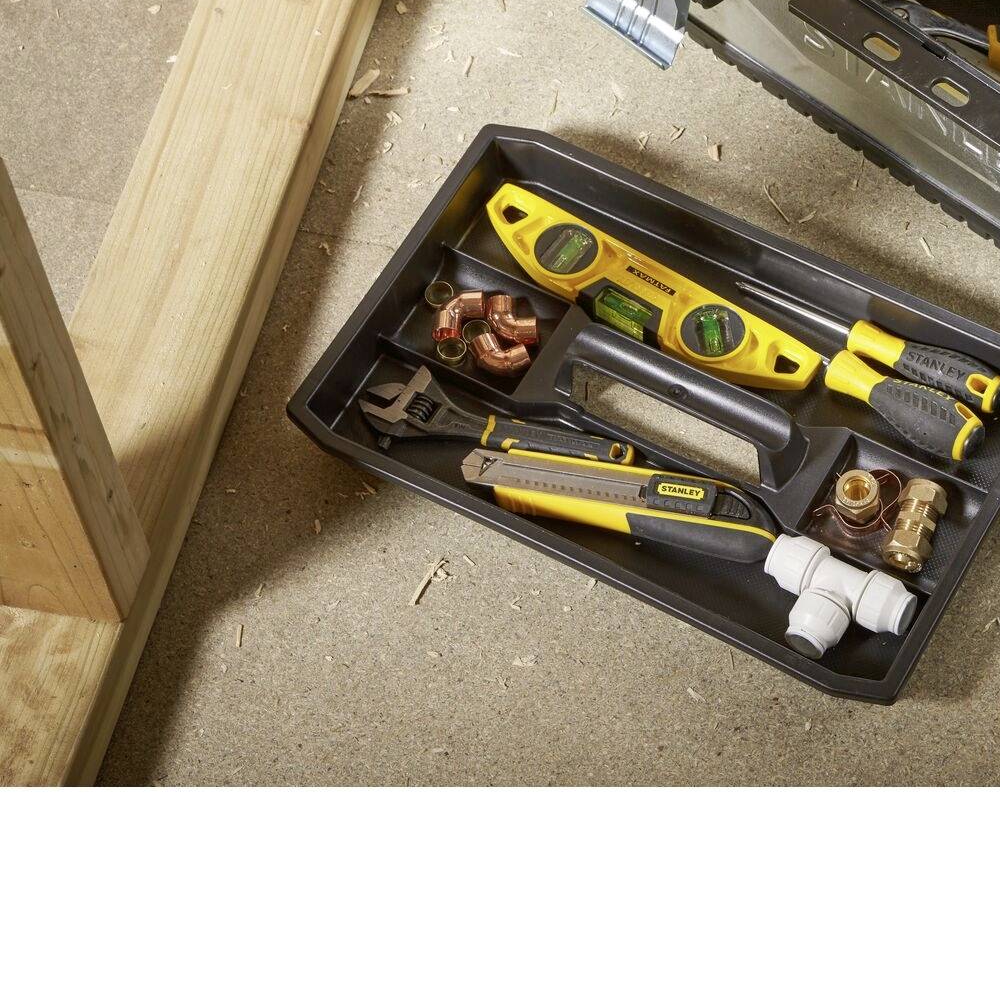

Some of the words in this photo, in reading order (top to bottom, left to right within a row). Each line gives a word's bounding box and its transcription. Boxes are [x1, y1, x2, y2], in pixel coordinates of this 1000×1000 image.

[632, 268, 672, 295] FATMAX
[908, 351, 966, 380] STANLEY
[893, 378, 955, 401] STANLEY
[660, 484, 702, 498] STANLEY
